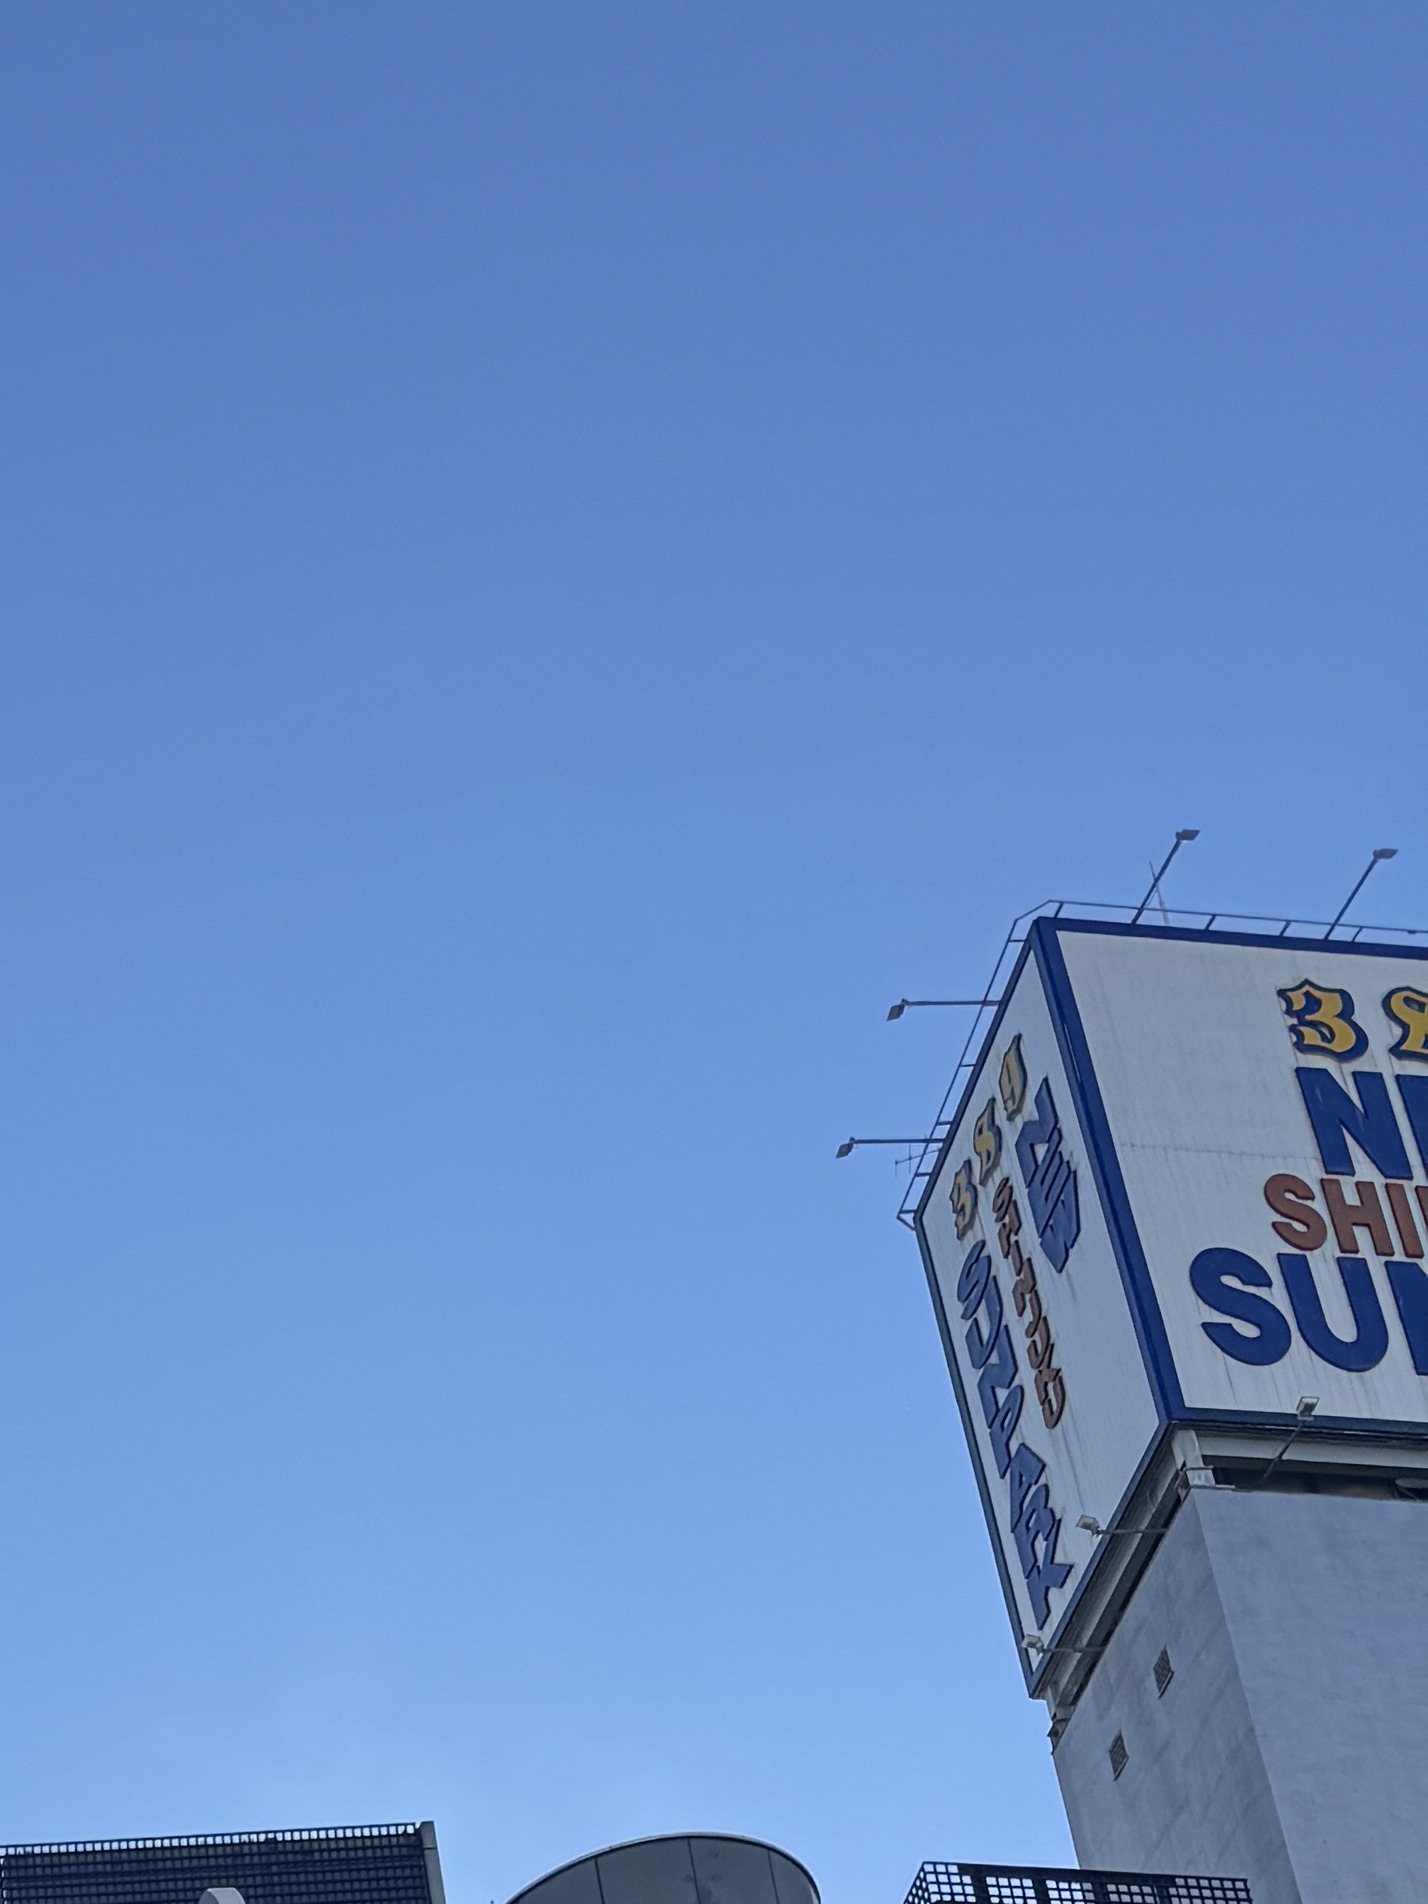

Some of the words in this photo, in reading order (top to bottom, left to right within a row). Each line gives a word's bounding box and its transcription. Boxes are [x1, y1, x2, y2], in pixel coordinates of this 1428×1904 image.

[1015, 1077, 1081, 1273] NEW
[1264, 1173, 1428, 1258] SHI
[992, 1176, 1067, 1429] SHINJUKU
[956, 1239, 1072, 1631] SUNPARK
